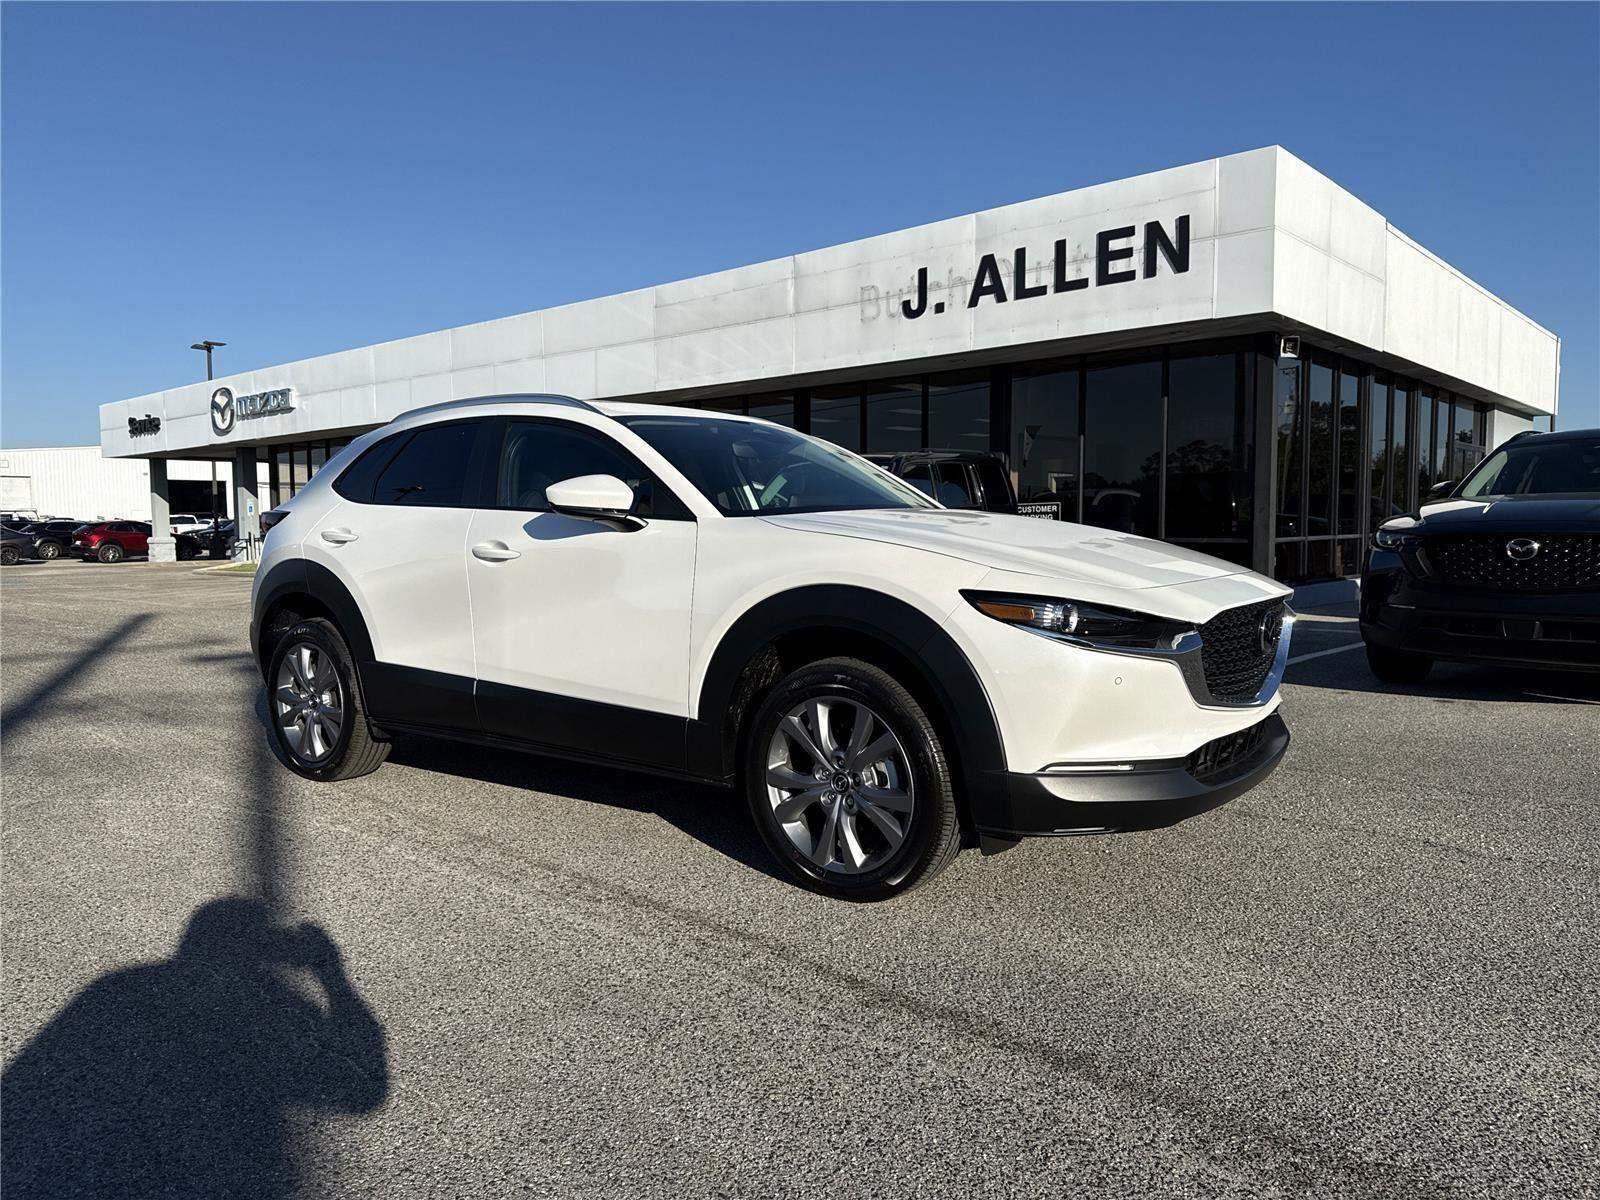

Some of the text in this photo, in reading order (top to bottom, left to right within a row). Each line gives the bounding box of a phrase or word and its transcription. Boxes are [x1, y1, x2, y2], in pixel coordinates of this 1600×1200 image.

[902, 267, 945, 319] J.
[967, 214, 1190, 309] ALLEN
[1017, 505, 1058, 513] CUSTOMER
